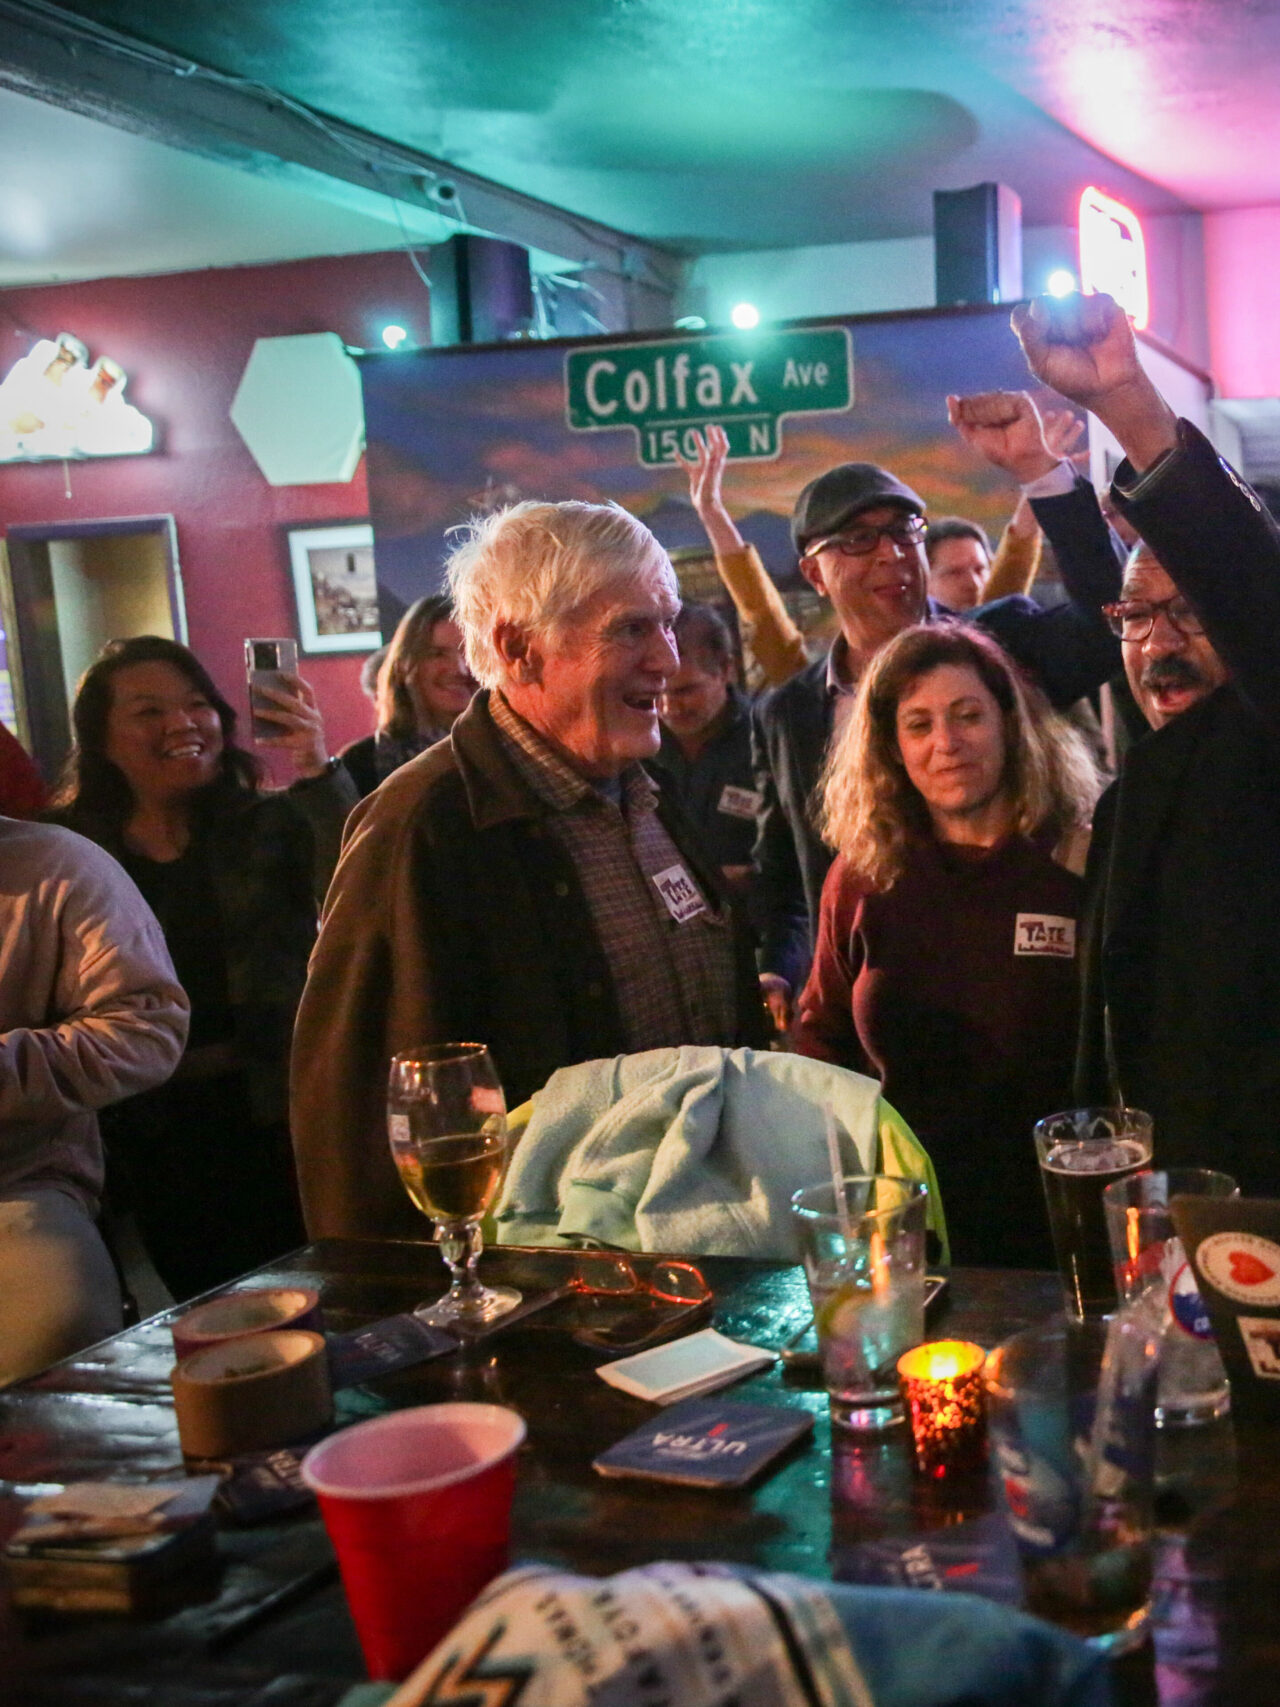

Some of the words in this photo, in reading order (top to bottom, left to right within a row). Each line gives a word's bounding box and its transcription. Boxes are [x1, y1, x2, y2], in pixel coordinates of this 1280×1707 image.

[584, 354, 759, 416] Colfax
[782, 358, 829, 388] Ave
[749, 423, 769, 452] N
[1025, 925, 1066, 943] TATE
[651, 1431, 748, 1455] ULTRA
